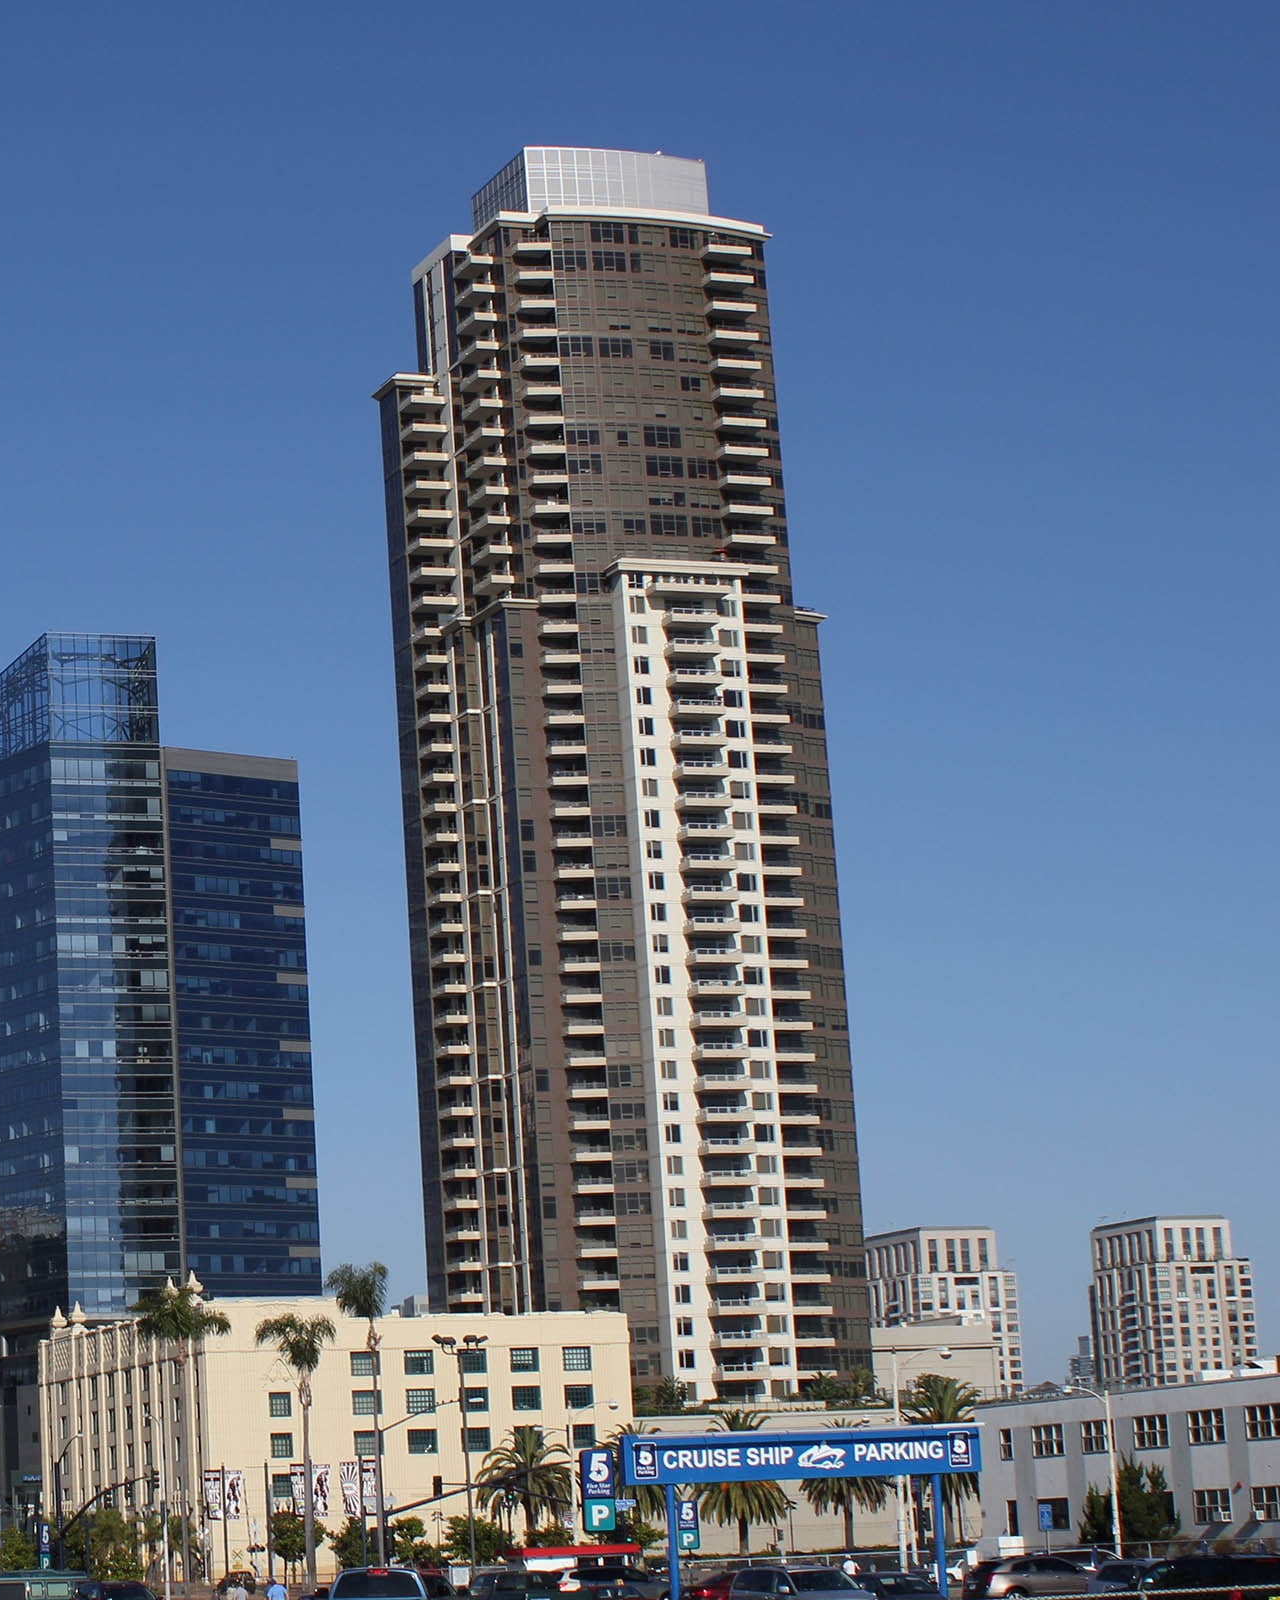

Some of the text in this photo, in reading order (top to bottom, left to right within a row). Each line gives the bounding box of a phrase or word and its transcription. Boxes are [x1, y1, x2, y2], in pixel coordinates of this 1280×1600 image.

[663, 1440, 944, 1468] CRUISE SHIP PARKING
[588, 1453, 609, 1482] 5
[591, 1505, 610, 1527] P
[681, 1502, 694, 1520] 5
[42, 1525, 49, 1544] 5
[682, 1533, 695, 1547] P
[43, 1557, 49, 1569] P
